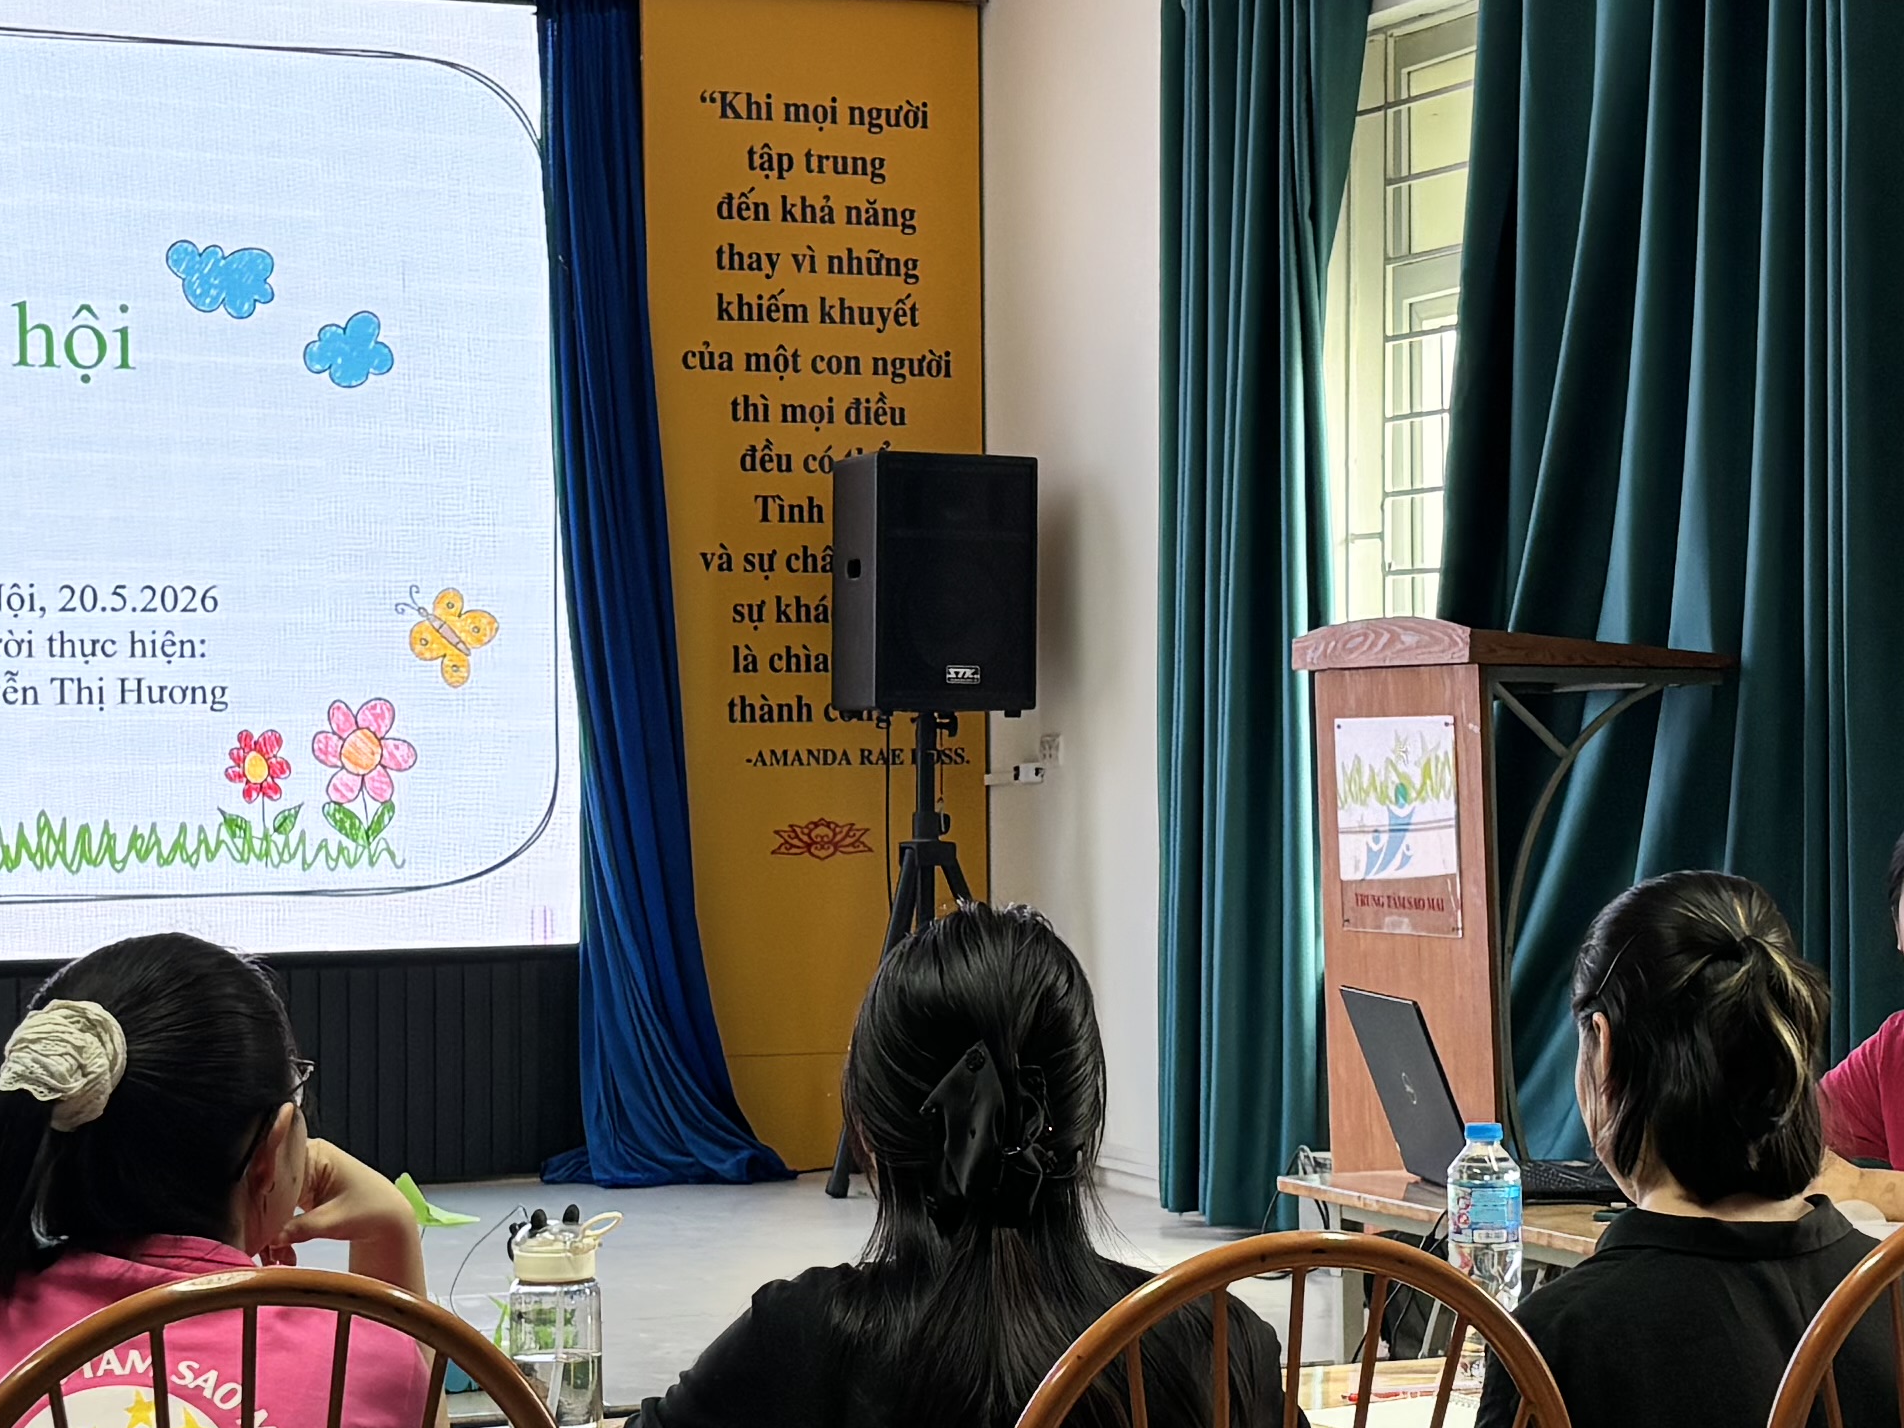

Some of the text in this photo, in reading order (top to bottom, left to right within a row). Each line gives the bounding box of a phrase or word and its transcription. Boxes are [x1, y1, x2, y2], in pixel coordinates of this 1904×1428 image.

[784, 96, 838, 132] mọi
[848, 99, 928, 135] người
[747, 142, 886, 185] tập trung
[716, 186, 917, 236] đến khả năng
[716, 242, 920, 285] thay vì những
[717, 288, 919, 334] khiếm khuyết
[11, 300, 136, 384] hội
[681, 340, 952, 385] của một con người
[730, 391, 907, 432] thì mọi điều
[740, 438, 833, 474] đều có
[754, 494, 825, 524] Tình
[699, 542, 734, 573] và
[743, 548, 778, 581] sự
[58, 584, 219, 613] 20.5.2026
[732, 599, 767, 632] sự
[46, 630, 117, 665] thực
[129, 629, 206, 665] hiện:
[732, 643, 830, 674] là chìa
[49, 676, 105, 712] Thị
[118, 677, 229, 713] Hương
[727, 693, 813, 724] thành
[746, 748, 851, 767] -AMANDA
[859, 748, 904, 766] RAE
[171, 1361, 242, 1410] SAO
